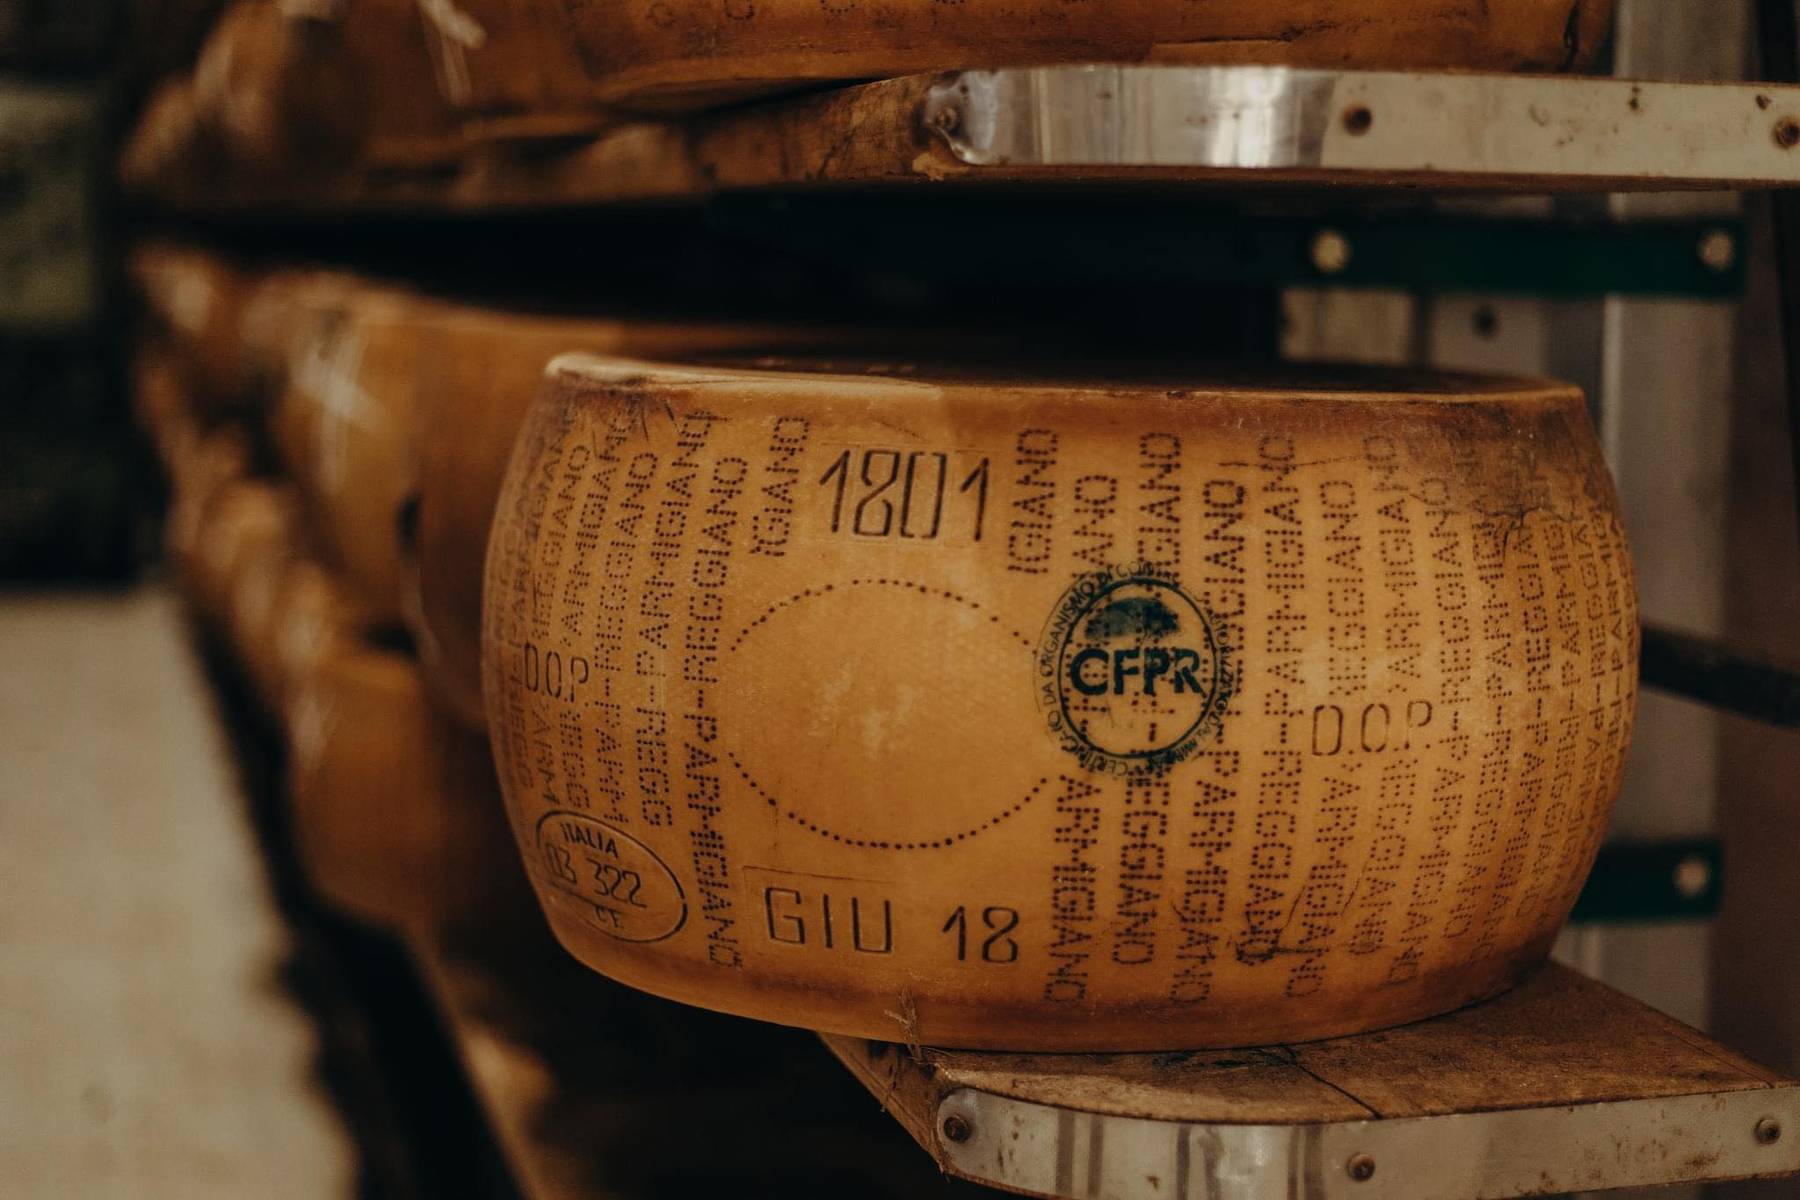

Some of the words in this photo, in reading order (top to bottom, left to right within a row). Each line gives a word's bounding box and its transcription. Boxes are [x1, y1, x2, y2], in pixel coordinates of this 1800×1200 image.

[594, 453, 658, 672] REGGIANO
[636, 411, 711, 678] PARMIGIANO
[684, 457, 748, 683] REGGIANO
[819, 450, 989, 542] 1801
[1070, 648, 1206, 695] CFPR
[587, 857, 648, 909] 322
[765, 886, 892, 955] GIU
[942, 905, 1020, 964] 18
[1043, 748, 1102, 1002] ARMIGIANO
[1111, 750, 1172, 966] EGGIANO
[1169, 751, 1238, 1004] PARMIGIANO
